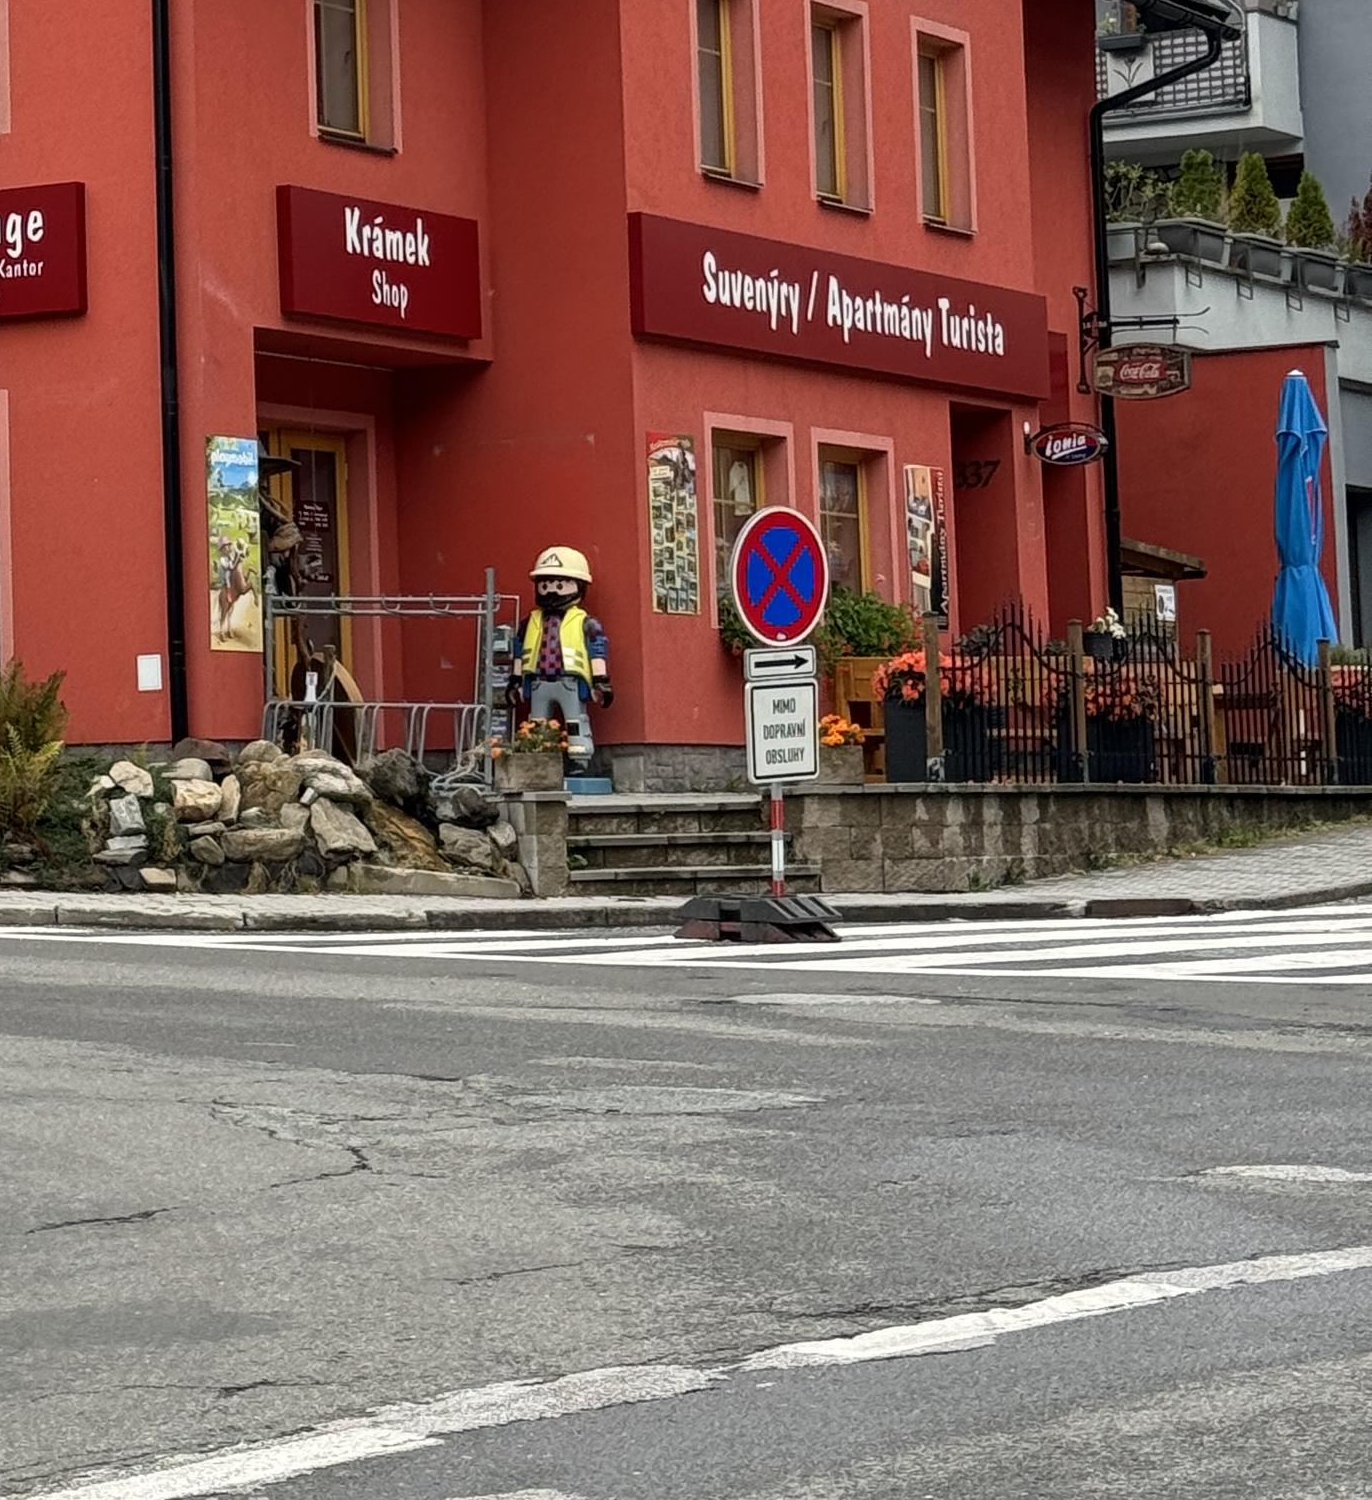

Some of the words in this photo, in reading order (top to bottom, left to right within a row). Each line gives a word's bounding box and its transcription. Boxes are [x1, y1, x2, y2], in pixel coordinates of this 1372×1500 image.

[344, 206, 430, 266] Krámek
[372, 269, 408, 318] Shop
[703, 250, 799, 335] Suvenýry
[807, 270, 818, 321] /
[828, 275, 932, 358] Apartmány
[938, 297, 1004, 356] Turista
[772, 698, 796, 714] MIMO
[763, 718, 806, 740] DOPRAVNÍ
[766, 746, 805, 765] OBSLUHY
